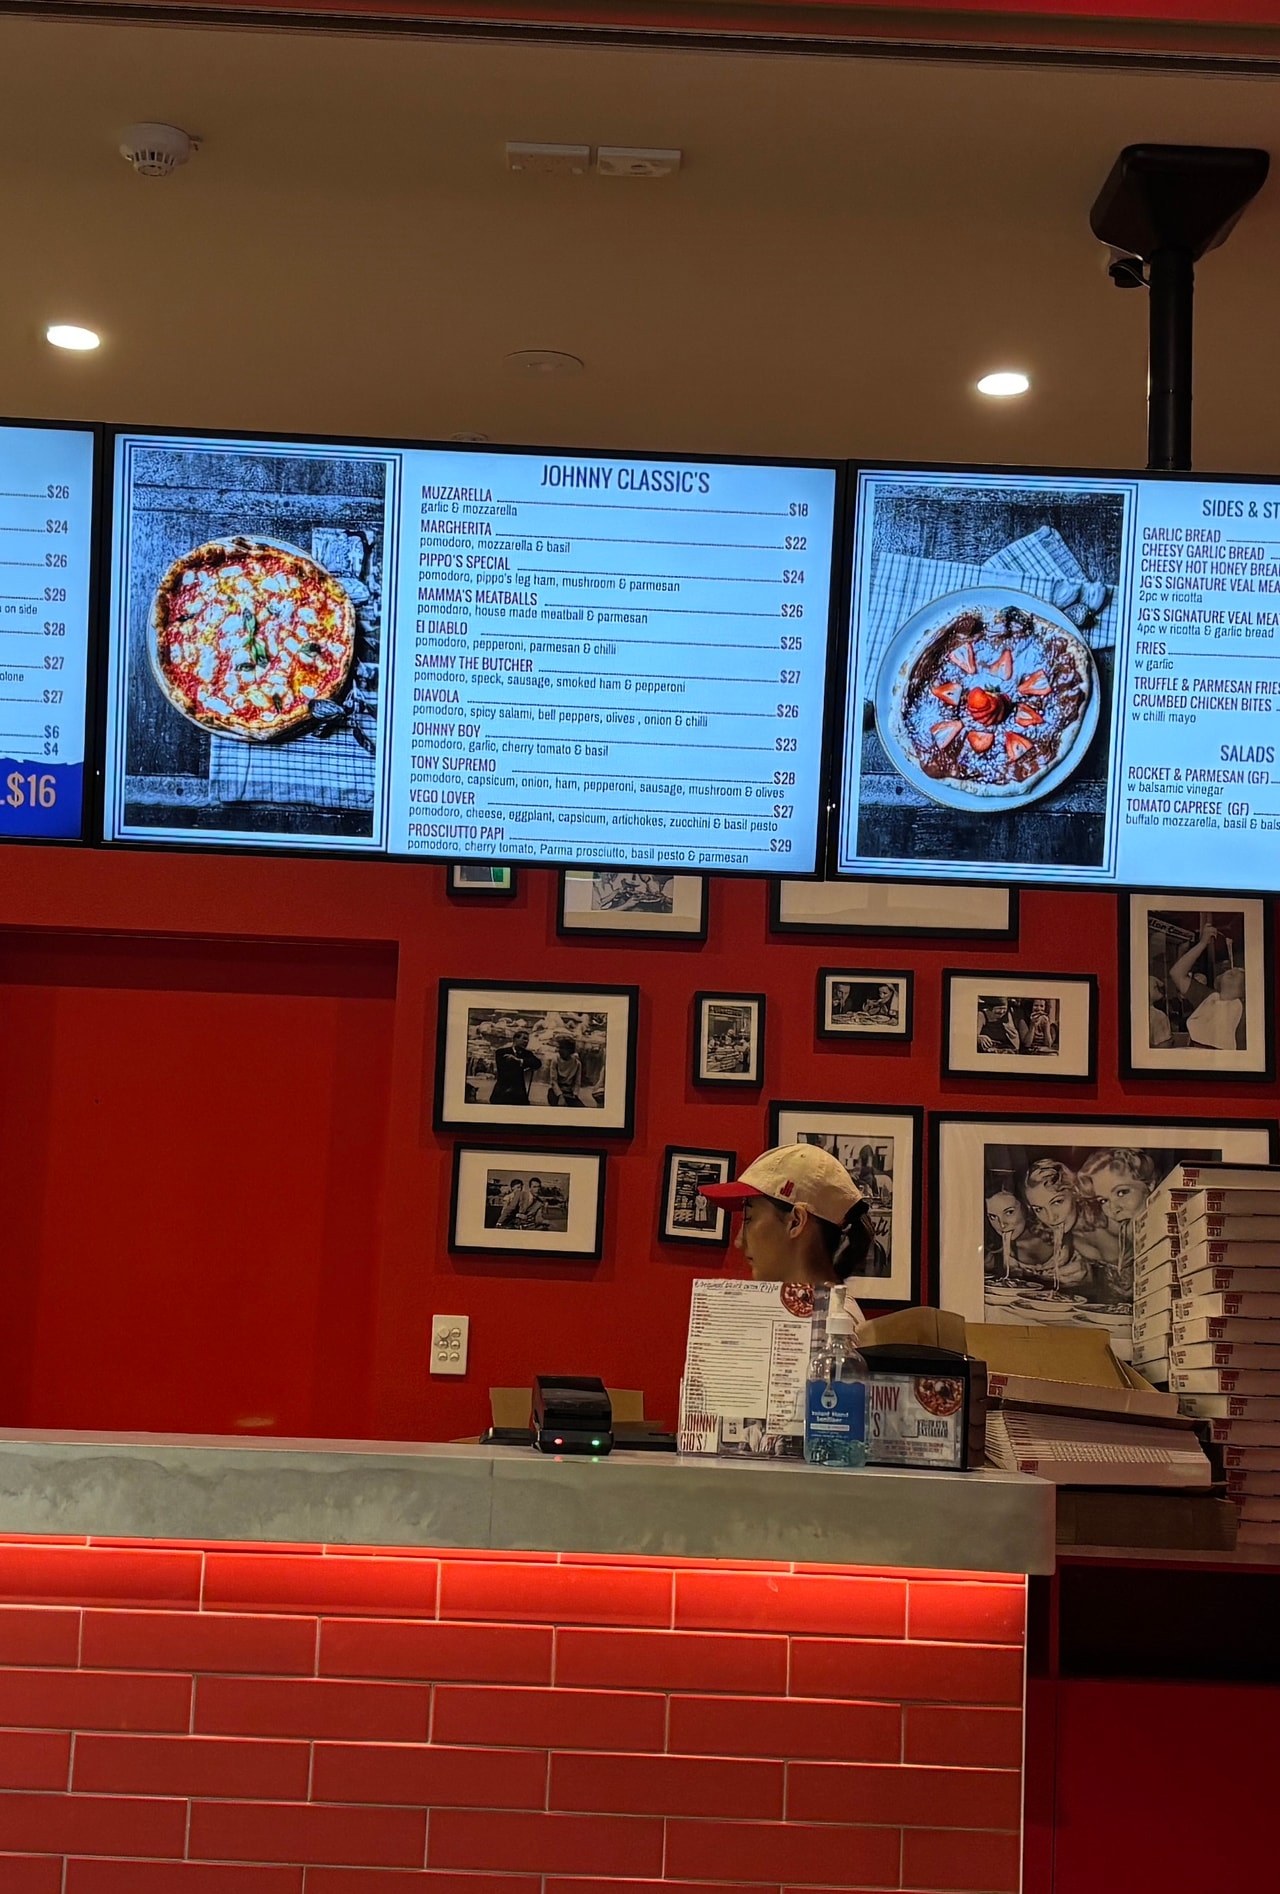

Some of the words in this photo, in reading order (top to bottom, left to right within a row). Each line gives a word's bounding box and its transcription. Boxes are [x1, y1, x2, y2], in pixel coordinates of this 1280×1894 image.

[540, 463, 613, 489] JOHNNY
[617, 467, 710, 494] CLASSIC'S
[46, 484, 70, 499] $26
[421, 484, 492, 502] MUZZARELLA
[788, 501, 809, 517] $18
[420, 500, 449, 514] garlic
[451, 501, 459, 514] &
[462, 503, 517, 517] mozzarella
[1201, 498, 1244, 517] SIDES
[1247, 500, 1258, 518] &
[419, 535, 474, 550] pomodoro,
[477, 539, 533, 551] mozzarella
[535, 539, 544, 552] &
[546, 540, 570, 553] basil
[420, 518, 492, 536] MARGHERITA
[784, 535, 807, 551] $22
[1142, 526, 1183, 542] GARLIC
[1184, 527, 1221, 543] BREAD
[418, 551, 463, 568] PIPPO'S
[465, 554, 511, 571] SPECIAL
[782, 568, 804, 584] $24
[1140, 557, 1183, 574] CHEESY
[1184, 559, 1208, 574] HOT
[1209, 560, 1248, 576] HONEY
[43, 586, 66, 602] $29
[417, 586, 472, 603] MAMMA'S
[474, 588, 538, 606] MEATBALLS
[780, 602, 803, 618] $26
[1135, 640, 1166, 655] FRIES
[414, 653, 457, 669] SAMMY
[458, 654, 480, 670] THE
[481, 656, 533, 673] BUTCHER
[779, 669, 801, 684] $27
[1134, 659, 1144, 668] w
[1145, 657, 1174, 672] garlic
[43, 724, 60, 739] $6
[1219, 744, 1275, 763] SALADS
[410, 754, 440, 770] TONY
[441, 756, 496, 772] SUPREMO
[773, 771, 796, 785] $28
[1125, 797, 1171, 813] TOMATO
[1173, 799, 1223, 815] CAPRESE
[1227, 801, 1249, 817] (GF)
